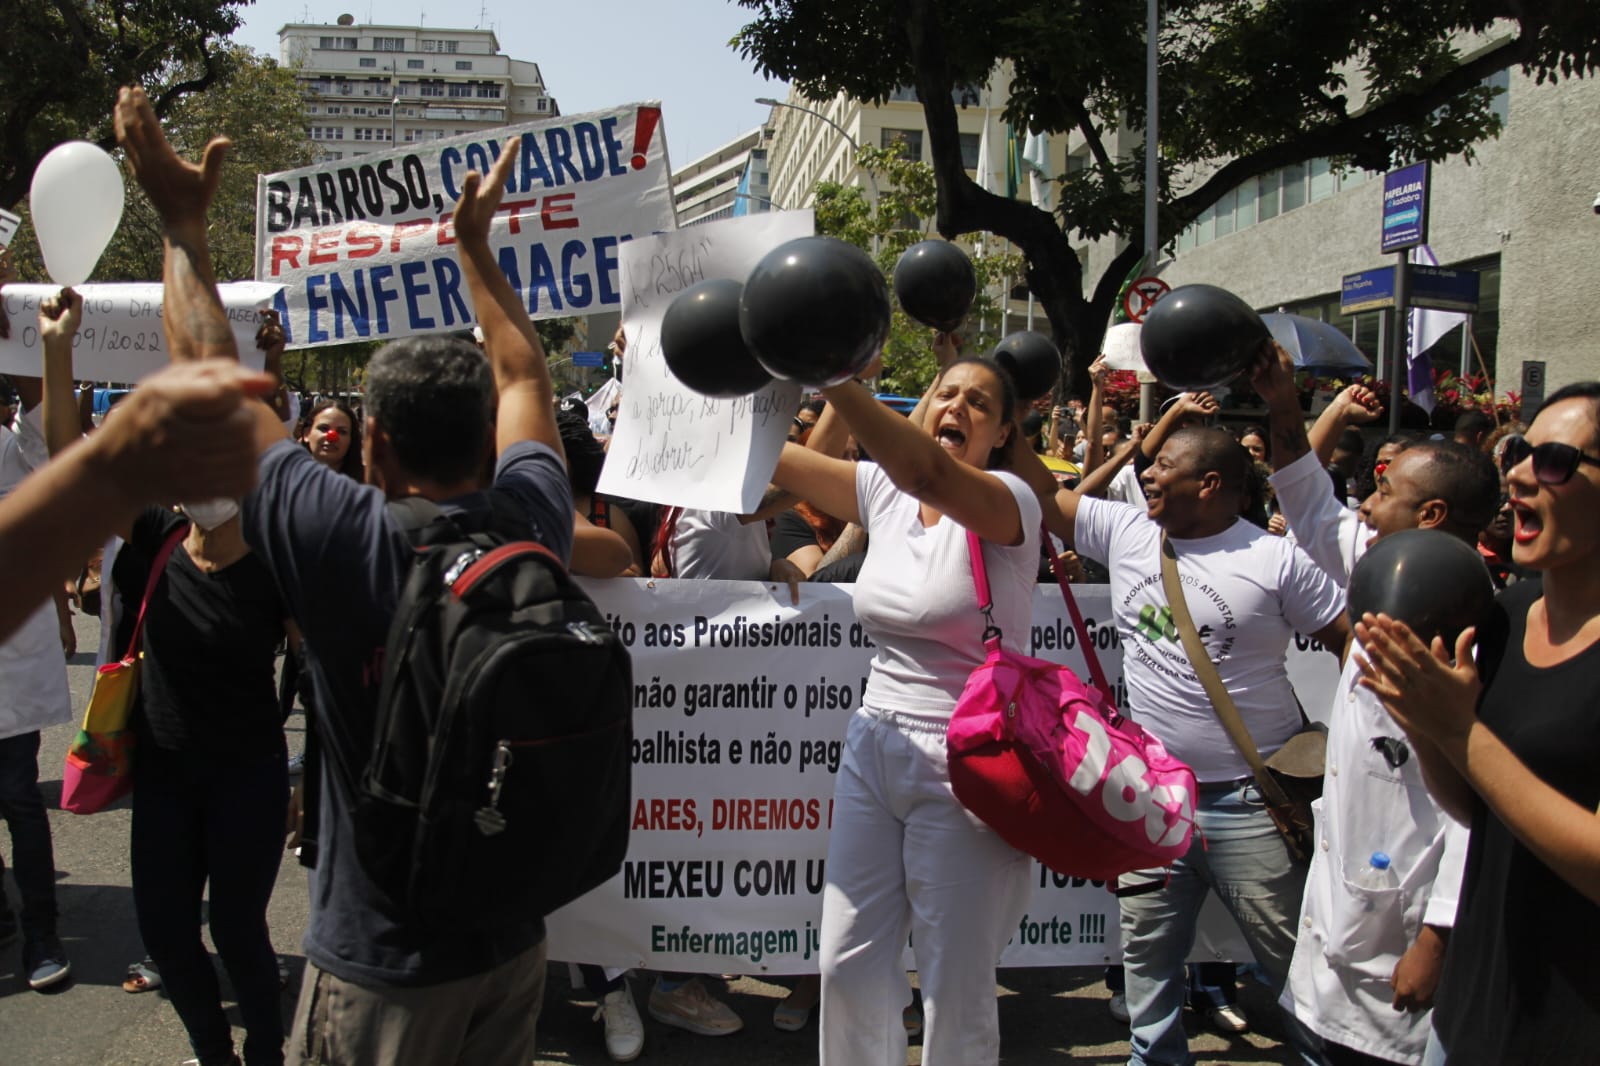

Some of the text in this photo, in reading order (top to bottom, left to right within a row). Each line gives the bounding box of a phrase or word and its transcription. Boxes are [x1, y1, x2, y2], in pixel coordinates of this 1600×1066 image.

[266, 153, 444, 233] BARROSO,
[1385, 181, 1422, 200] PAPELARIA
[271, 192, 579, 276] RESPETE
[306, 231, 668, 343] ENFERAGE
[1123, 572, 1163, 607] MOVIME
[1199, 583, 1236, 630] ATIVISTAS
[644, 622, 686, 648] aos
[694, 614, 843, 648] Profissionais
[1030, 617, 1075, 658] pelo
[634, 675, 677, 708] não
[683, 675, 777, 717] garantir
[784, 684, 798, 709] o
[805, 677, 853, 718] piso
[728, 739, 742, 765] e
[750, 731, 792, 765] não
[631, 799, 703, 838] ARES,
[712, 798, 821, 831] DIREMOS
[624, 860, 724, 899] MEXEU
[734, 859, 796, 897] COM
[652, 924, 798, 962] Enfermagem
[1019, 914, 1072, 945] forte
